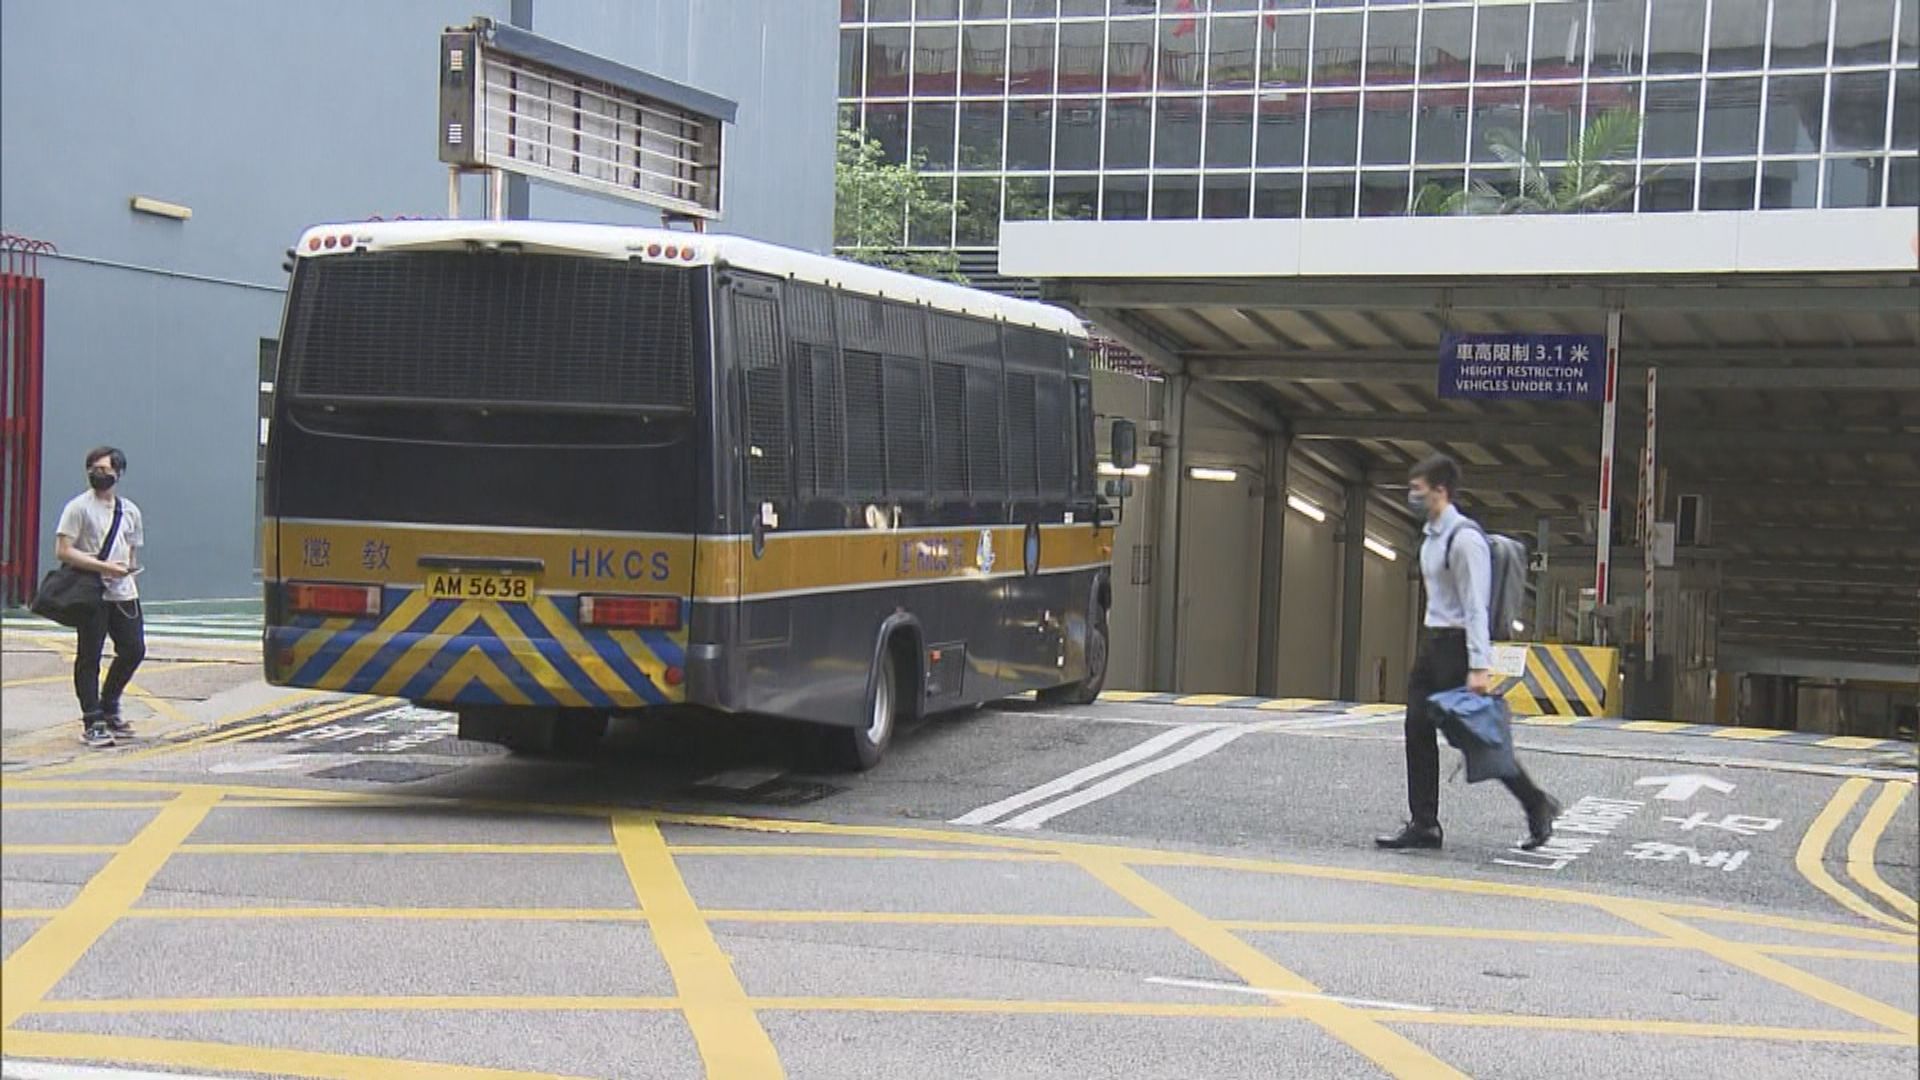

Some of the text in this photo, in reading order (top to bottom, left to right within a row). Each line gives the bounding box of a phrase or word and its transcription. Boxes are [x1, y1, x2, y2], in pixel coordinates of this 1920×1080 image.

[1456, 343, 1590, 363] 車高限制 3.1 米
[1460, 365, 1583, 378] HEIGHT RESTRICTION
[1456, 379, 1588, 393] VEHICLES UNDER 3.1 M
[570, 547, 671, 582] HKCS
[433, 575, 527, 598] AM 5638
